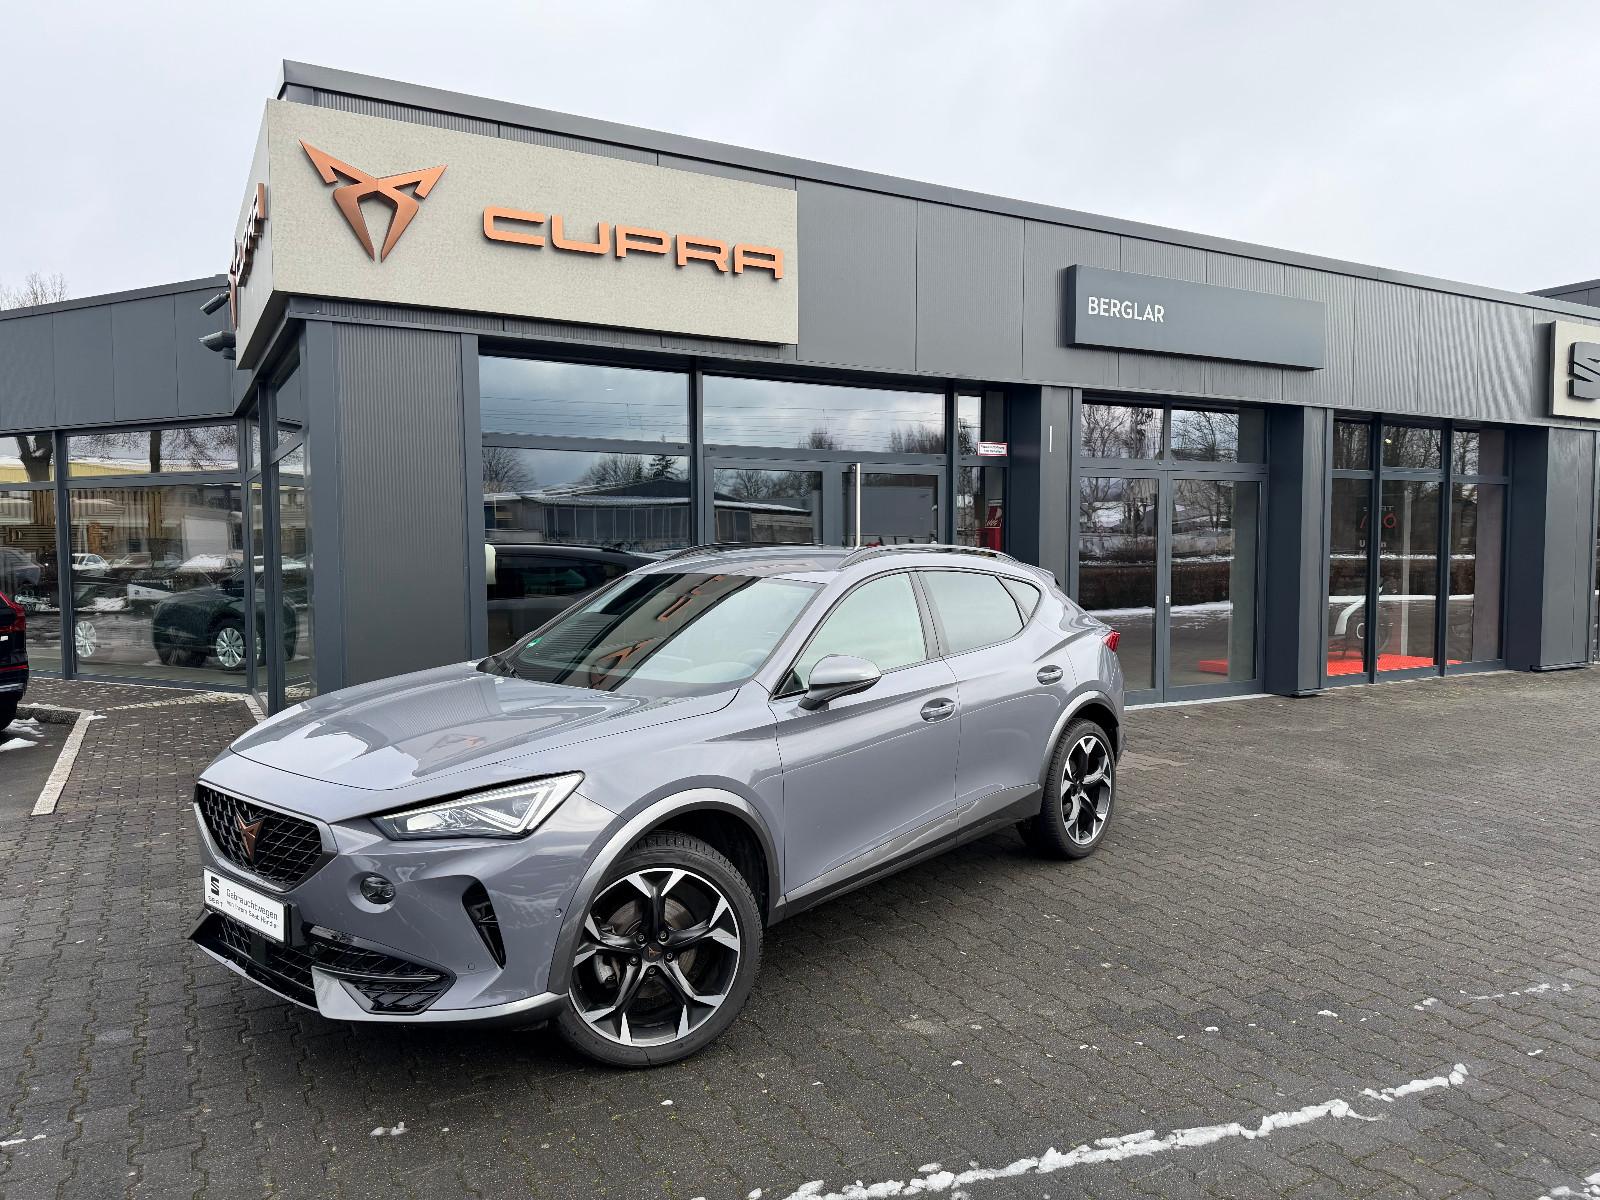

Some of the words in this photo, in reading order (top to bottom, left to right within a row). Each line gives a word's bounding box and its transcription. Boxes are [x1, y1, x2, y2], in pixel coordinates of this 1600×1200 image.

[483, 206, 785, 280] CUPRA
[1087, 296, 1165, 323] BERGLAR
[226, 888, 278, 921] Gebrauchtwagen
